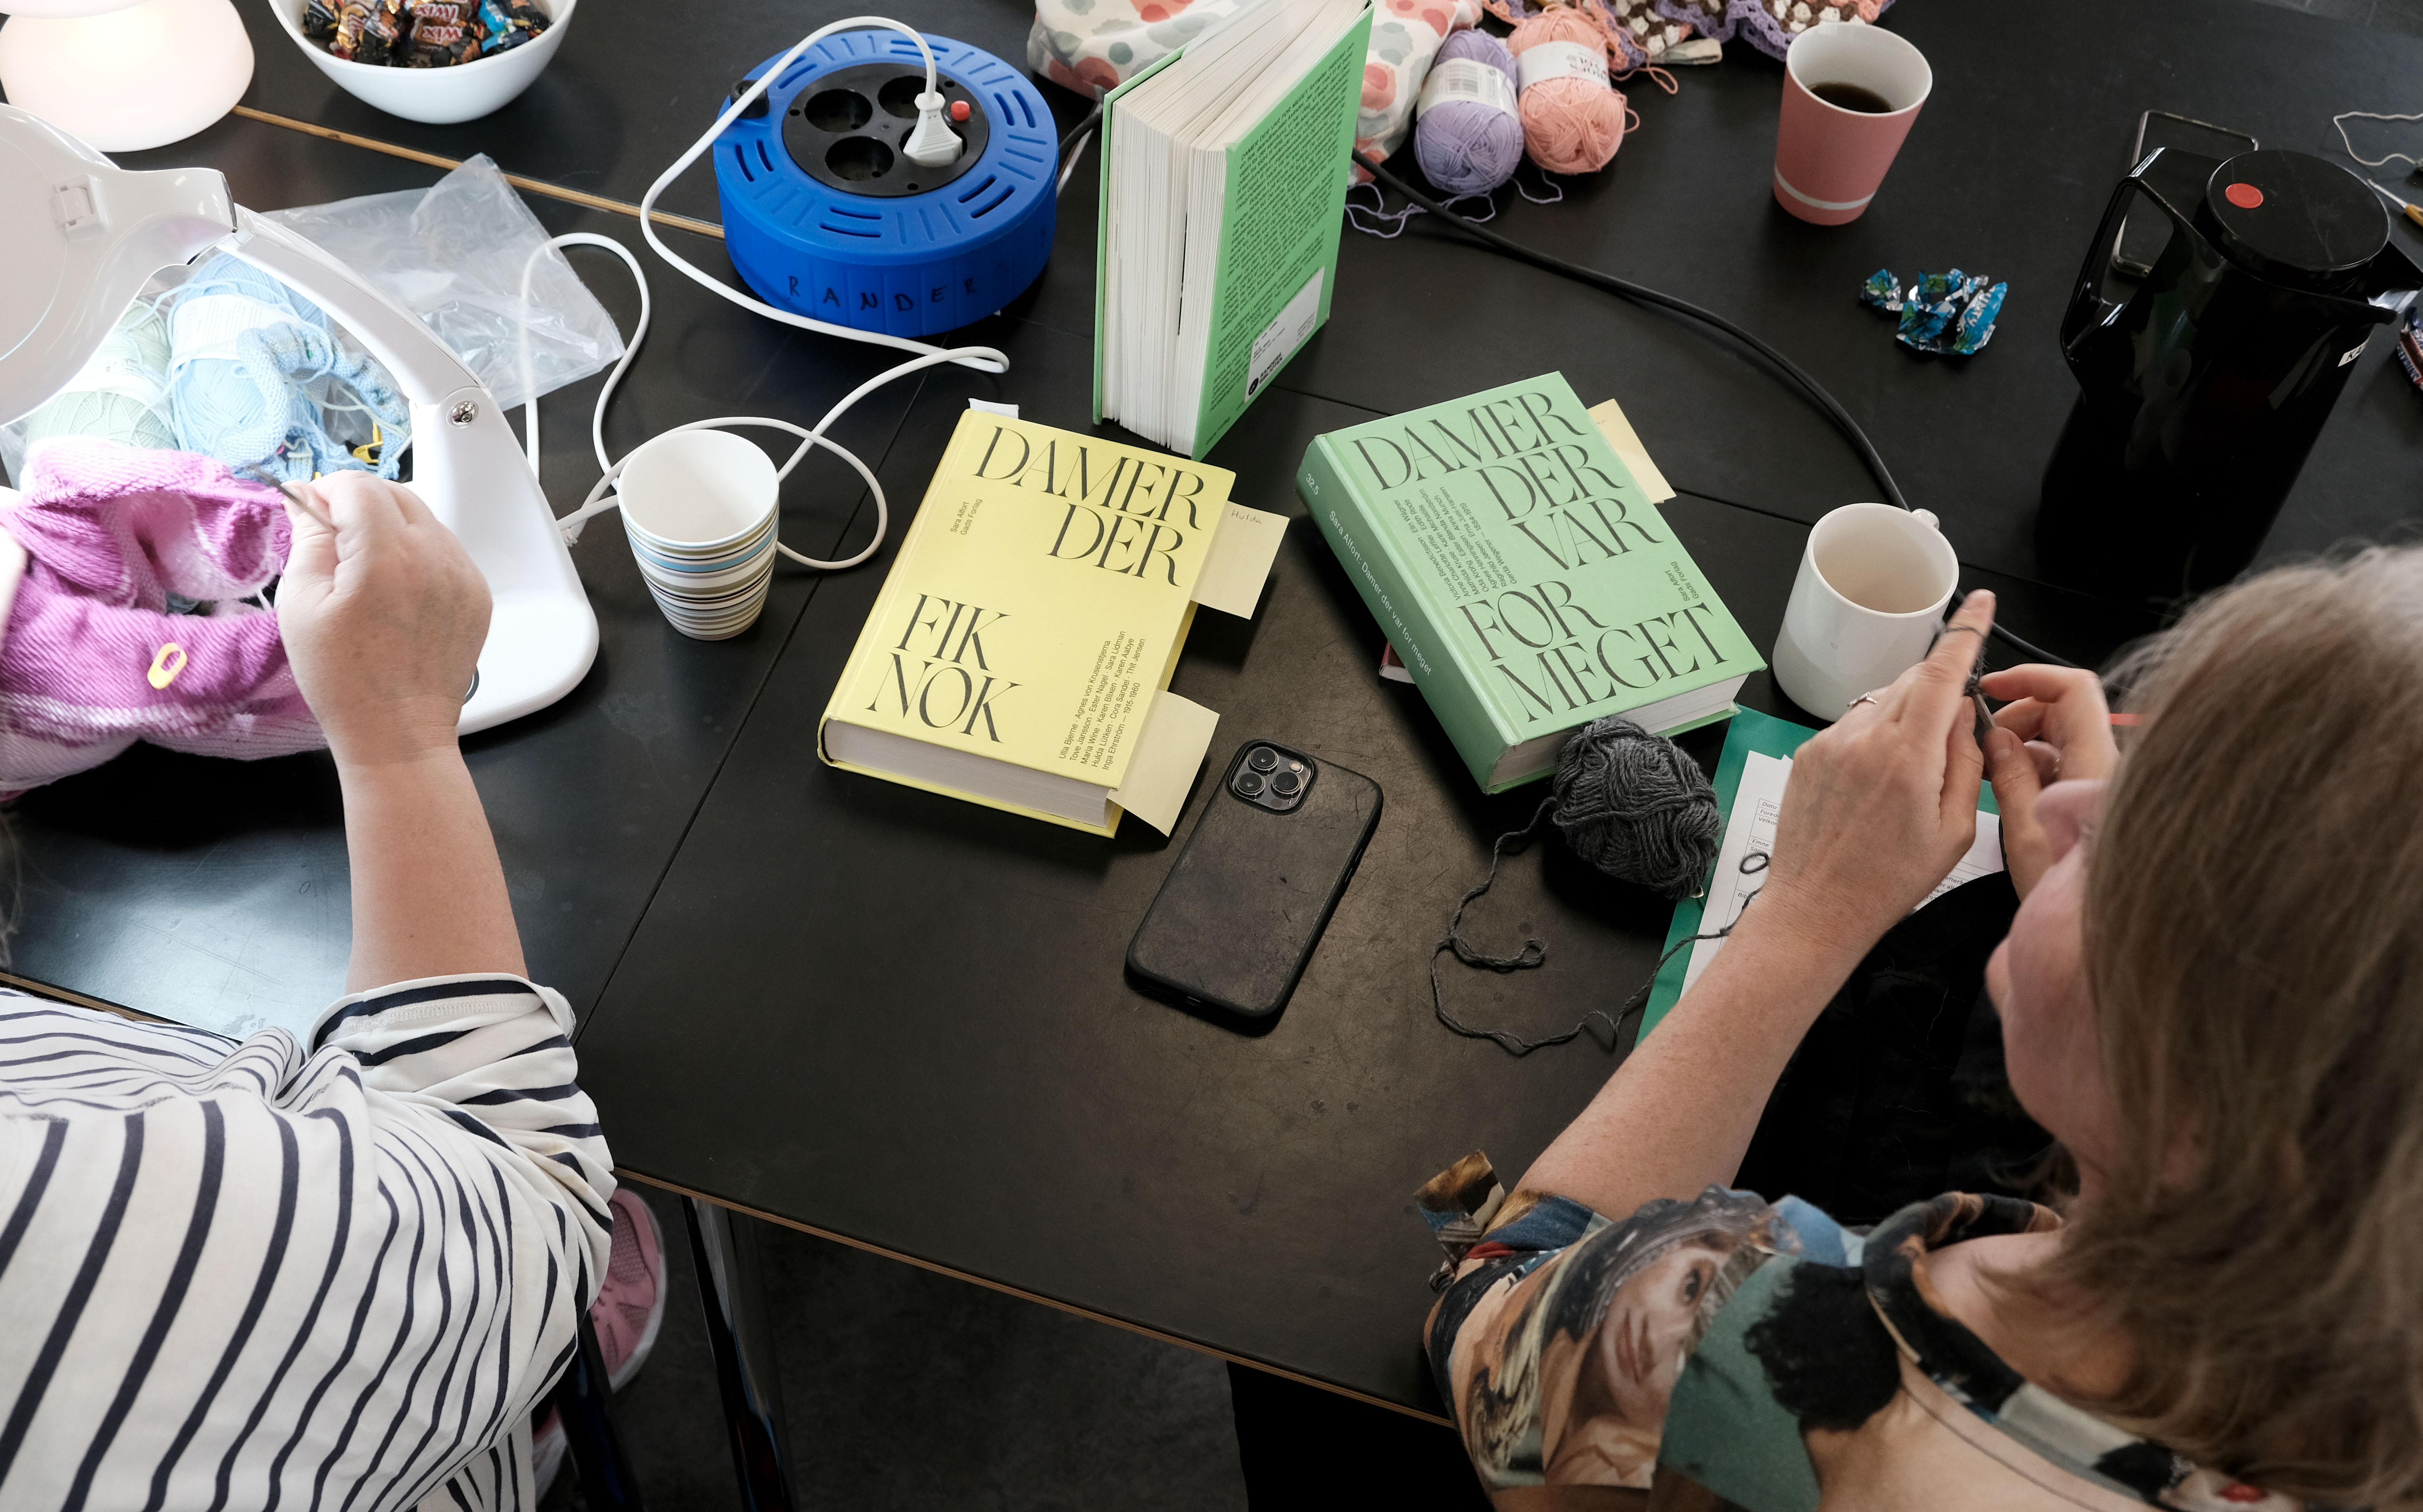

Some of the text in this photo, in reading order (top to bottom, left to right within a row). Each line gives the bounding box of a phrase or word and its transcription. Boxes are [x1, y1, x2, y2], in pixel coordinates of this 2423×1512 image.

[1241, 139, 1259, 161] DAMER
[1259, 127, 1269, 142] DER
[1271, 117, 1280, 130] VAR
[1281, 106, 1291, 120] FOR
[1292, 88, 1308, 109] MEGET
[788, 271, 990, 311] RANDER
[1351, 392, 1587, 491] DAMER
[973, 426, 1206, 530] DAMER
[1306, 472, 1319, 495] 32.5
[1475, 444, 1623, 521] DER
[949, 501, 969, 533] Sara Alfort
[960, 498, 983, 535] Gads Forlag
[1231, 509, 1262, 524] Hulda
[1404, 499, 1417, 515] Rode
[1408, 522, 1418, 533] Elin
[1414, 514, 1427, 530] Edith
[1510, 497, 1663, 571] VAR
[1046, 503, 1185, 587] DER
[1417, 536, 1446, 577] Benedictsson
[1419, 488, 1489, 592] Oda Krohg Ester Blenda Nordström
[1434, 495, 1499, 589] Agnes Henningsen Anna Munch
[1436, 532, 1450, 547] Karin
[1439, 553, 1460, 581] Charlotte
[1448, 551, 1463, 569] Kruse
[1459, 502, 1517, 584] Gerda Wegener 1884-1919
[1329, 510, 1431, 676] Sara Alfort: Damer der var for meget
[1443, 576, 1461, 601] Victoria
[1457, 581, 1471, 597] Anne
[1460, 568, 1480, 595] Mathilda
[1486, 560, 1508, 587] Ragnhild
[1664, 569, 1690, 602] Sara Alfort
[1670, 561, 1699, 599] Gads Forlag
[895, 593, 1010, 671] FIK
[1456, 580, 1610, 662] FOR
[1493, 601, 1730, 723] MEGET
[865, 652, 1021, 743] NOK
[1058, 640, 1111, 759] Ulla Bjerne Agnes von Krusenstjerna
[1069, 631, 1126, 761] Tove Jansson Ester Nagel Sara Lidman
[1079, 638, 1134, 765] Maria Wine Karen Blixen Karen Aabye
[1090, 638, 1146, 768] Hulda Lütken Cora Sandel Thit Jensen
[1101, 682, 1140, 770] Inga Ehrström 1915-1960
[1752, 839, 1769, 847] Emne
